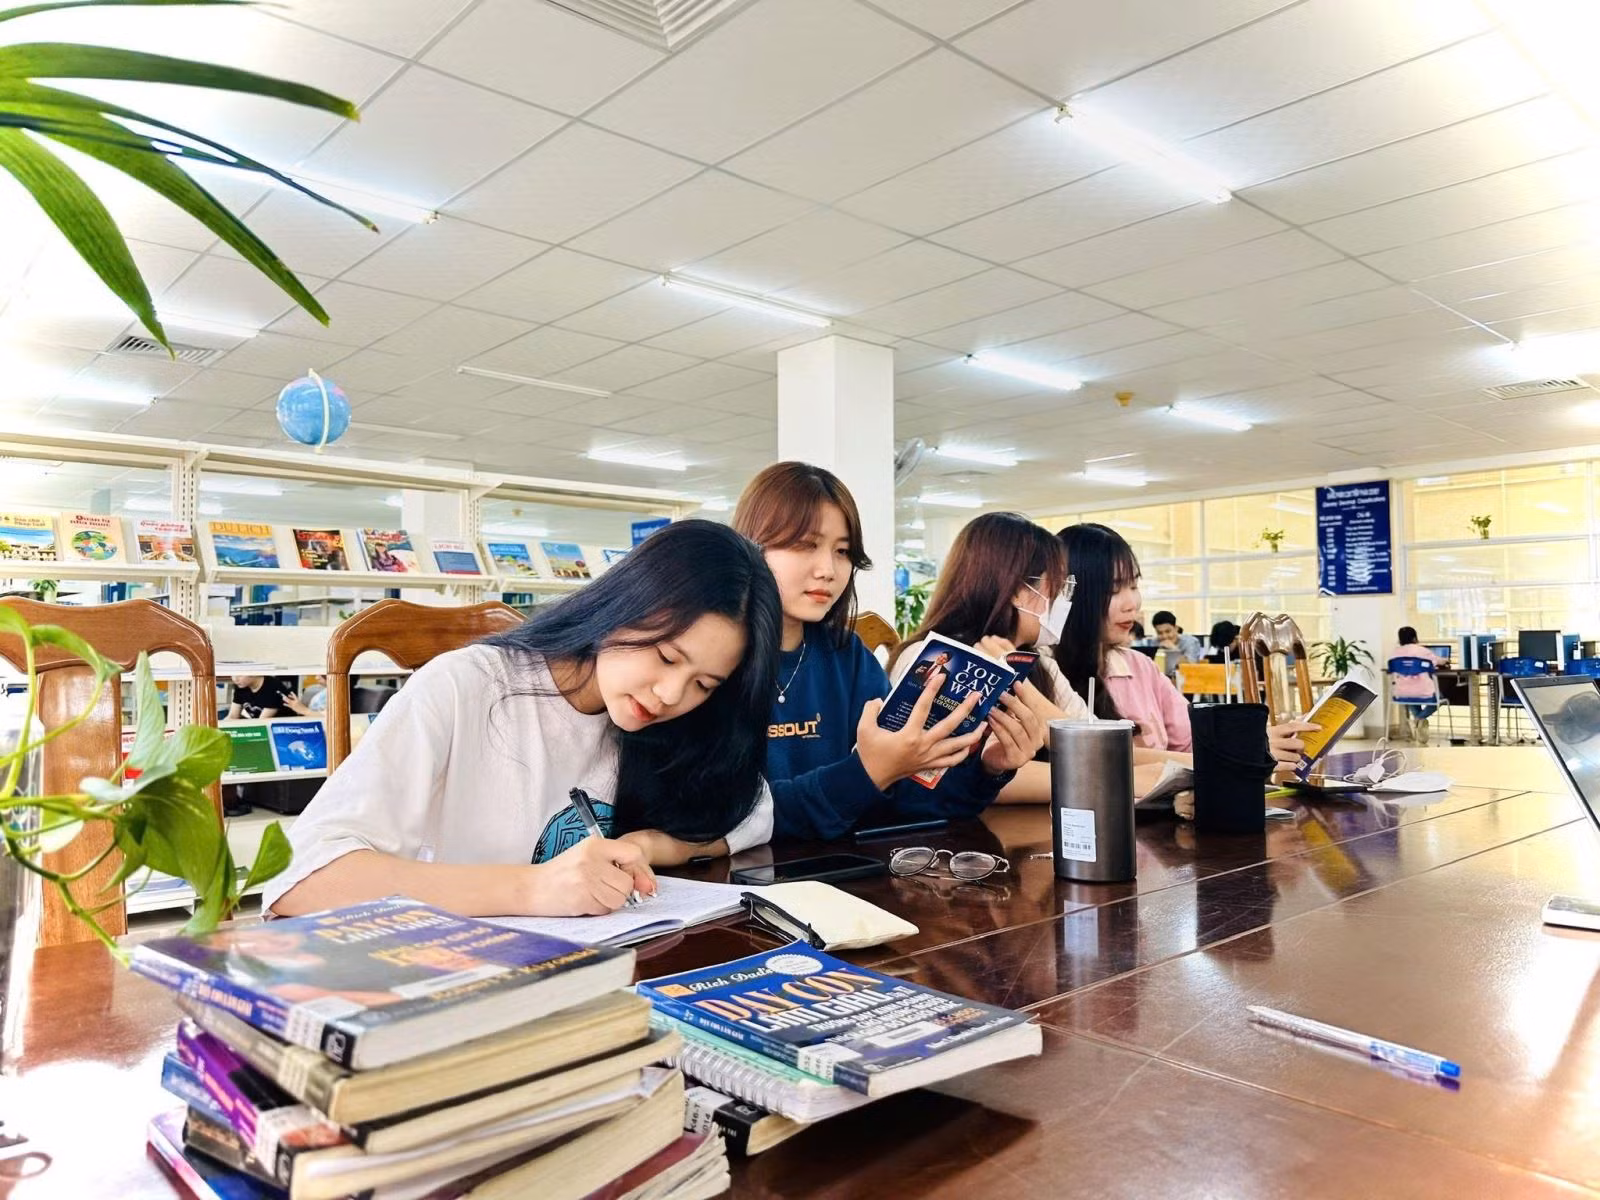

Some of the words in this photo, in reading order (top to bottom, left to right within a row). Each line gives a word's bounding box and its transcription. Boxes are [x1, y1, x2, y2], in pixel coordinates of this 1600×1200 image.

[955, 672, 996, 697] CAN
[963, 660, 1002, 686] YOU
[950, 681, 988, 707] WIN
[688, 978, 729, 993] Rich
[782, 968, 884, 1001] CON
